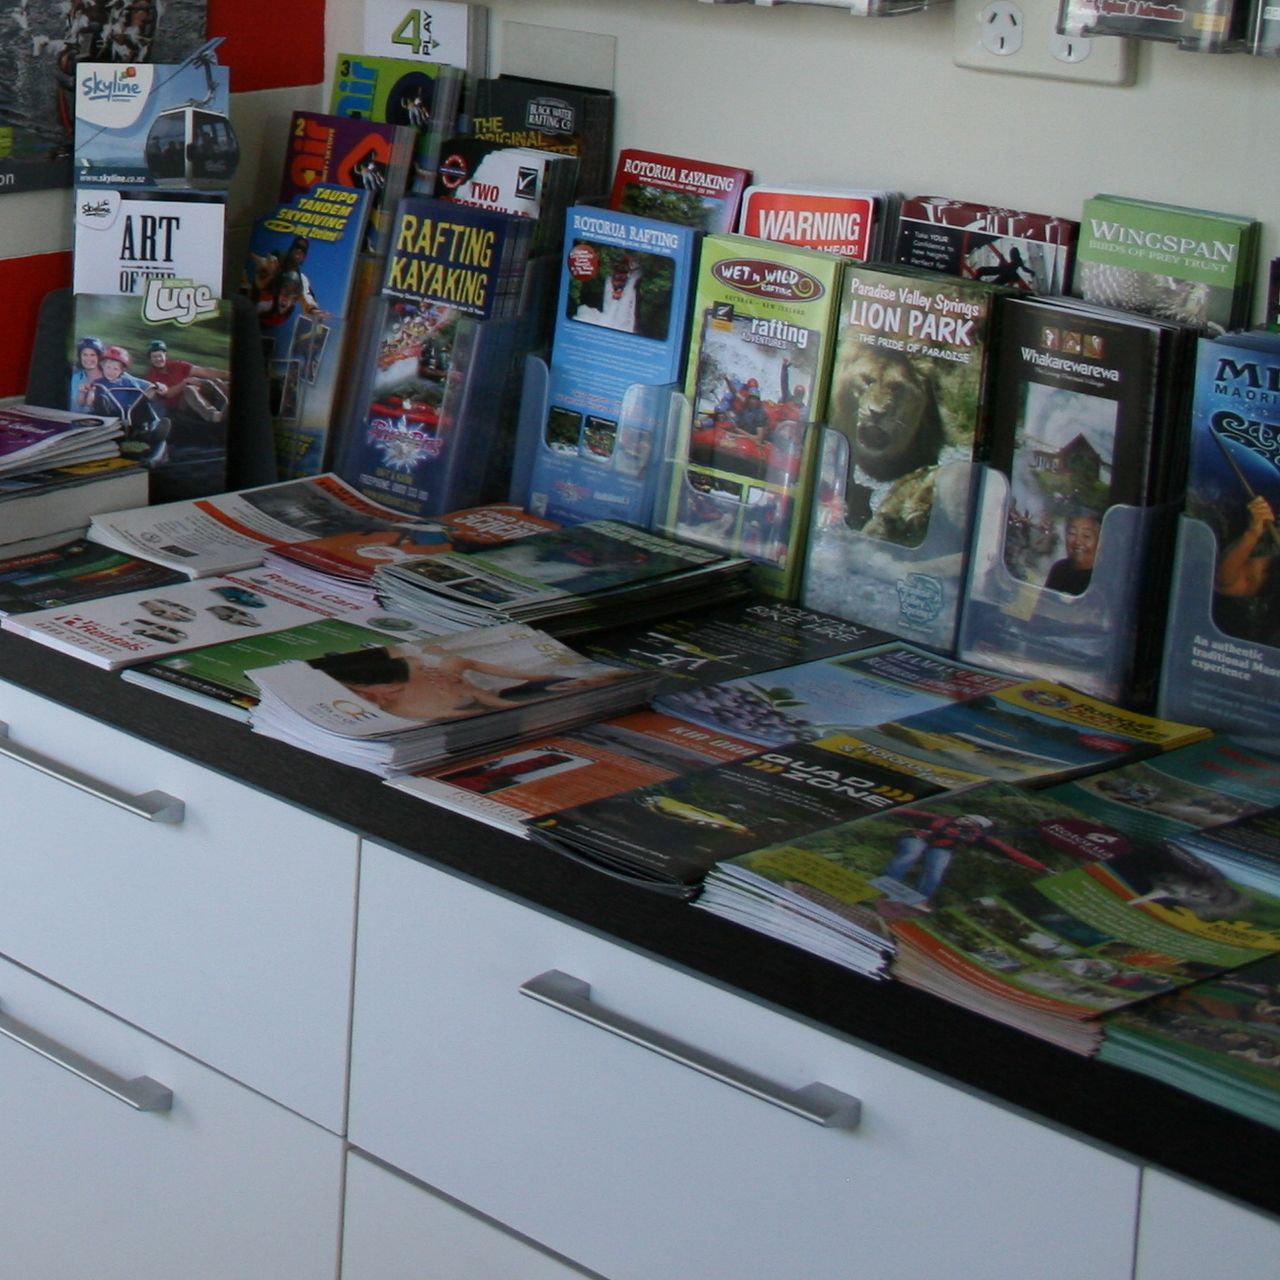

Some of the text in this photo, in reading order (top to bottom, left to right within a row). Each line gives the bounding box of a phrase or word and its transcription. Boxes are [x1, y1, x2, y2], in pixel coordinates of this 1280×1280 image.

[391, 8, 433, 56] 4 PLAY
[473, 116, 504, 133] THE
[471, 182, 500, 203] TWO
[623, 158, 735, 192] ROTORUA KAYAKING
[119, 214, 181, 262] ART
[396, 213, 495, 268] RAFTING
[573, 214, 679, 250] ROTORUA RAFTING
[759, 208, 861, 241] WARNING
[1090, 218, 1236, 263] WINGSPAN
[721, 264, 800, 285] WET WILD
[1088, 239, 1230, 274] BIRDS OF PREY TRUST
[119, 270, 140, 294] OF
[388, 255, 489, 307] KAYAKING
[851, 277, 980, 320] Paradise Valley Springs
[751, 318, 809, 349] rafting
[849, 299, 976, 347] LION PARK
[857, 332, 972, 365] THE PRIDE OF PARADISE
[1020, 345, 1120, 383] Whakarewarewa
[760, 752, 877, 789] QUAD
[780, 769, 895, 808] ZONE
